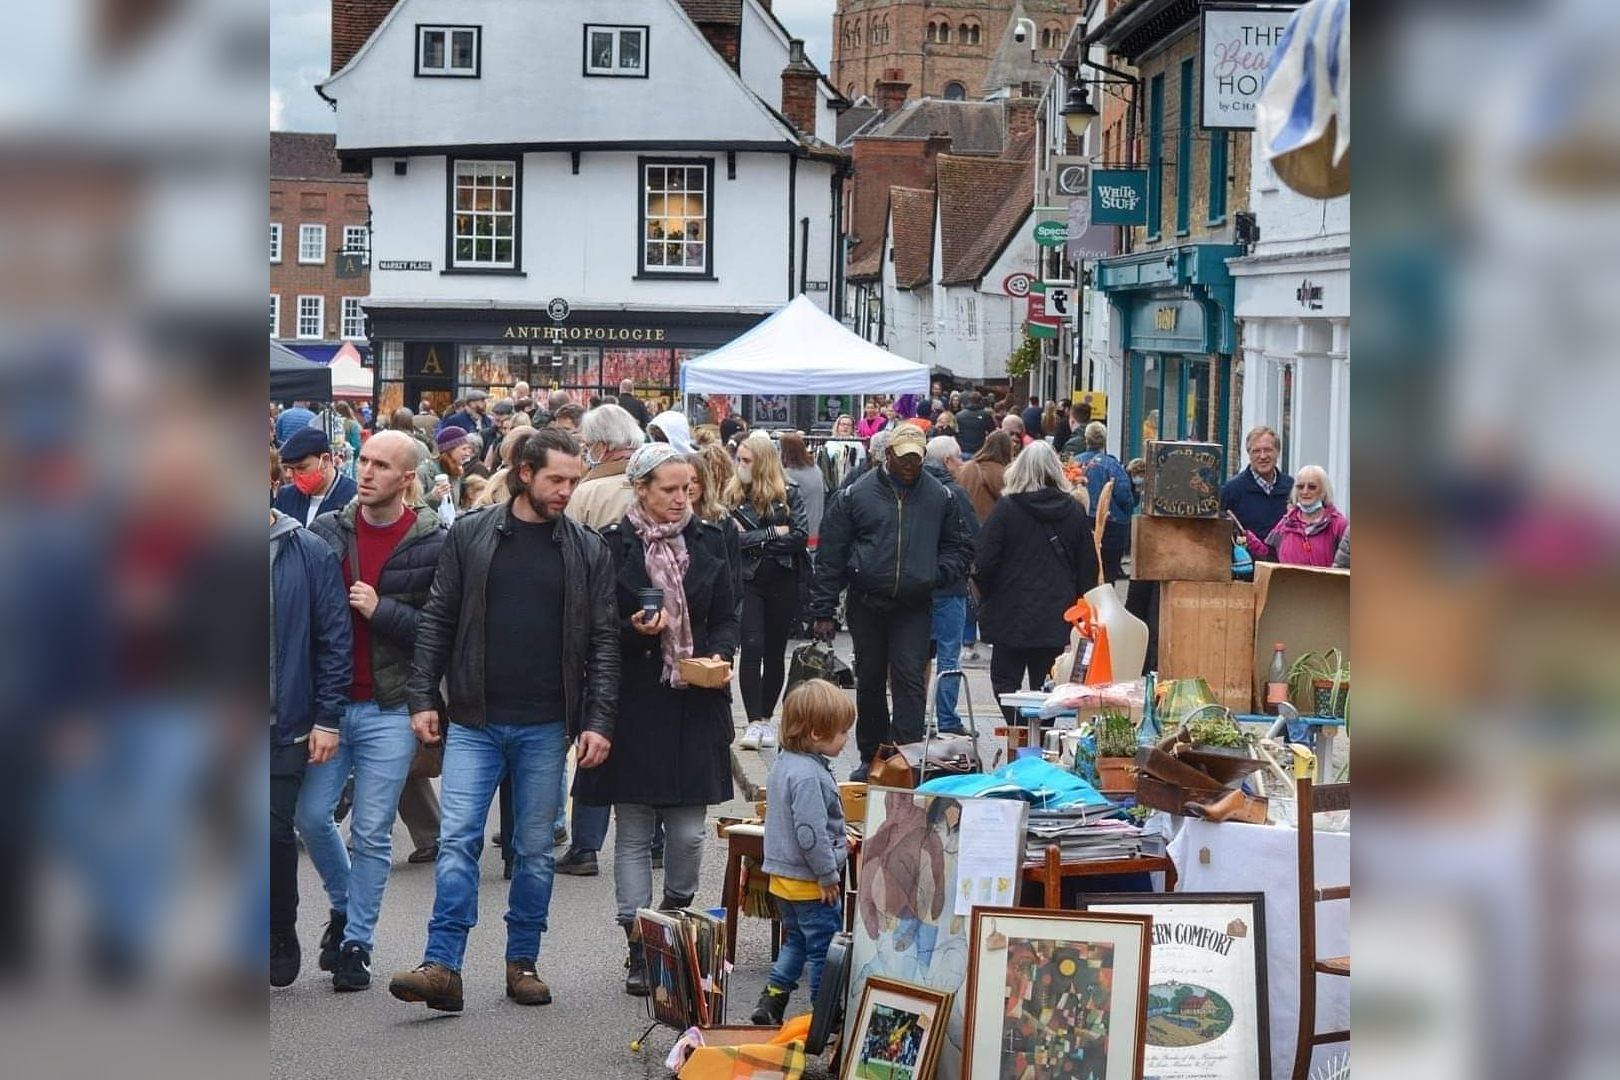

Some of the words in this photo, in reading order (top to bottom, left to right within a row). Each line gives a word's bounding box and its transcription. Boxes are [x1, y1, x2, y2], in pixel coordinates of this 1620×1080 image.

[1213, 39, 1268, 80] Bea
[1232, 101, 1256, 111] CHA
[505, 326, 665, 341] ANTHROPOLOGIE
[421, 345, 443, 374] A
[1151, 923, 1172, 945] ERN
[1175, 923, 1235, 956] COMFORT
